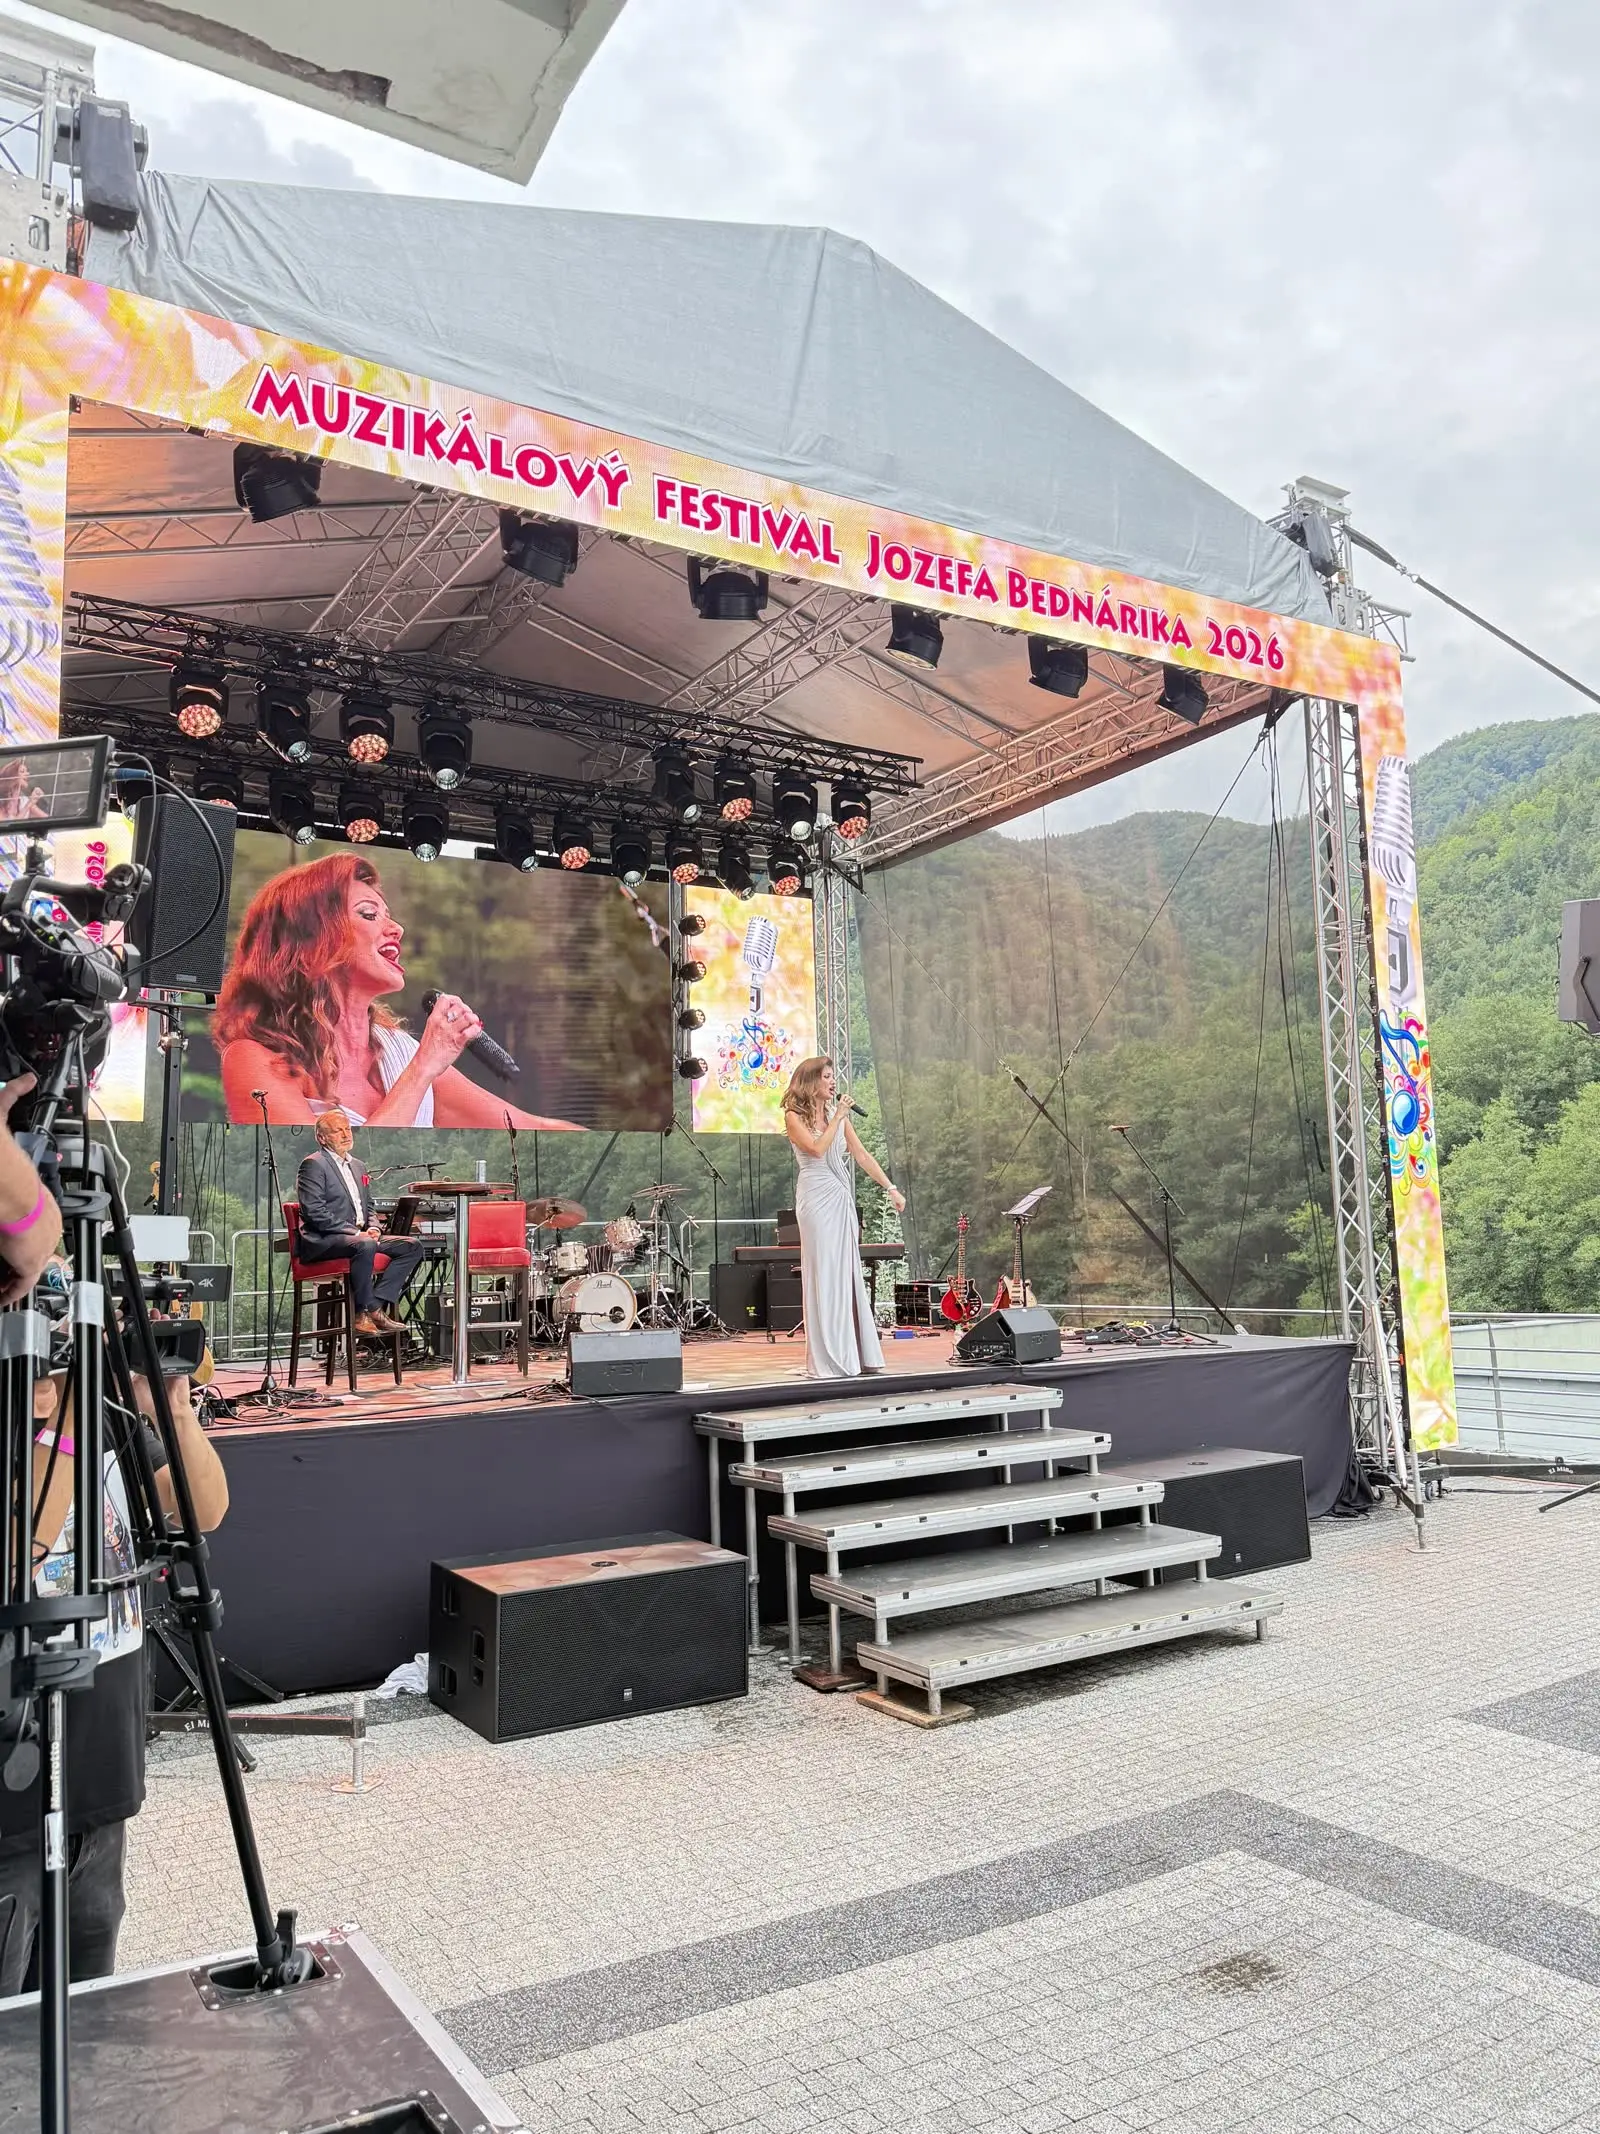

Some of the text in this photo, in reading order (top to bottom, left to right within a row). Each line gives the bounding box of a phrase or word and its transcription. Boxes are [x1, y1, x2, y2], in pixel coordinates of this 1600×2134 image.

[248, 366, 1286, 671] MUZIKÁLOVÝ FESTIVAL JOZEFA BEDNÁRIKA 2026
[198, 1277, 214, 1288] 4K
[184, 1721, 195, 1732] El
